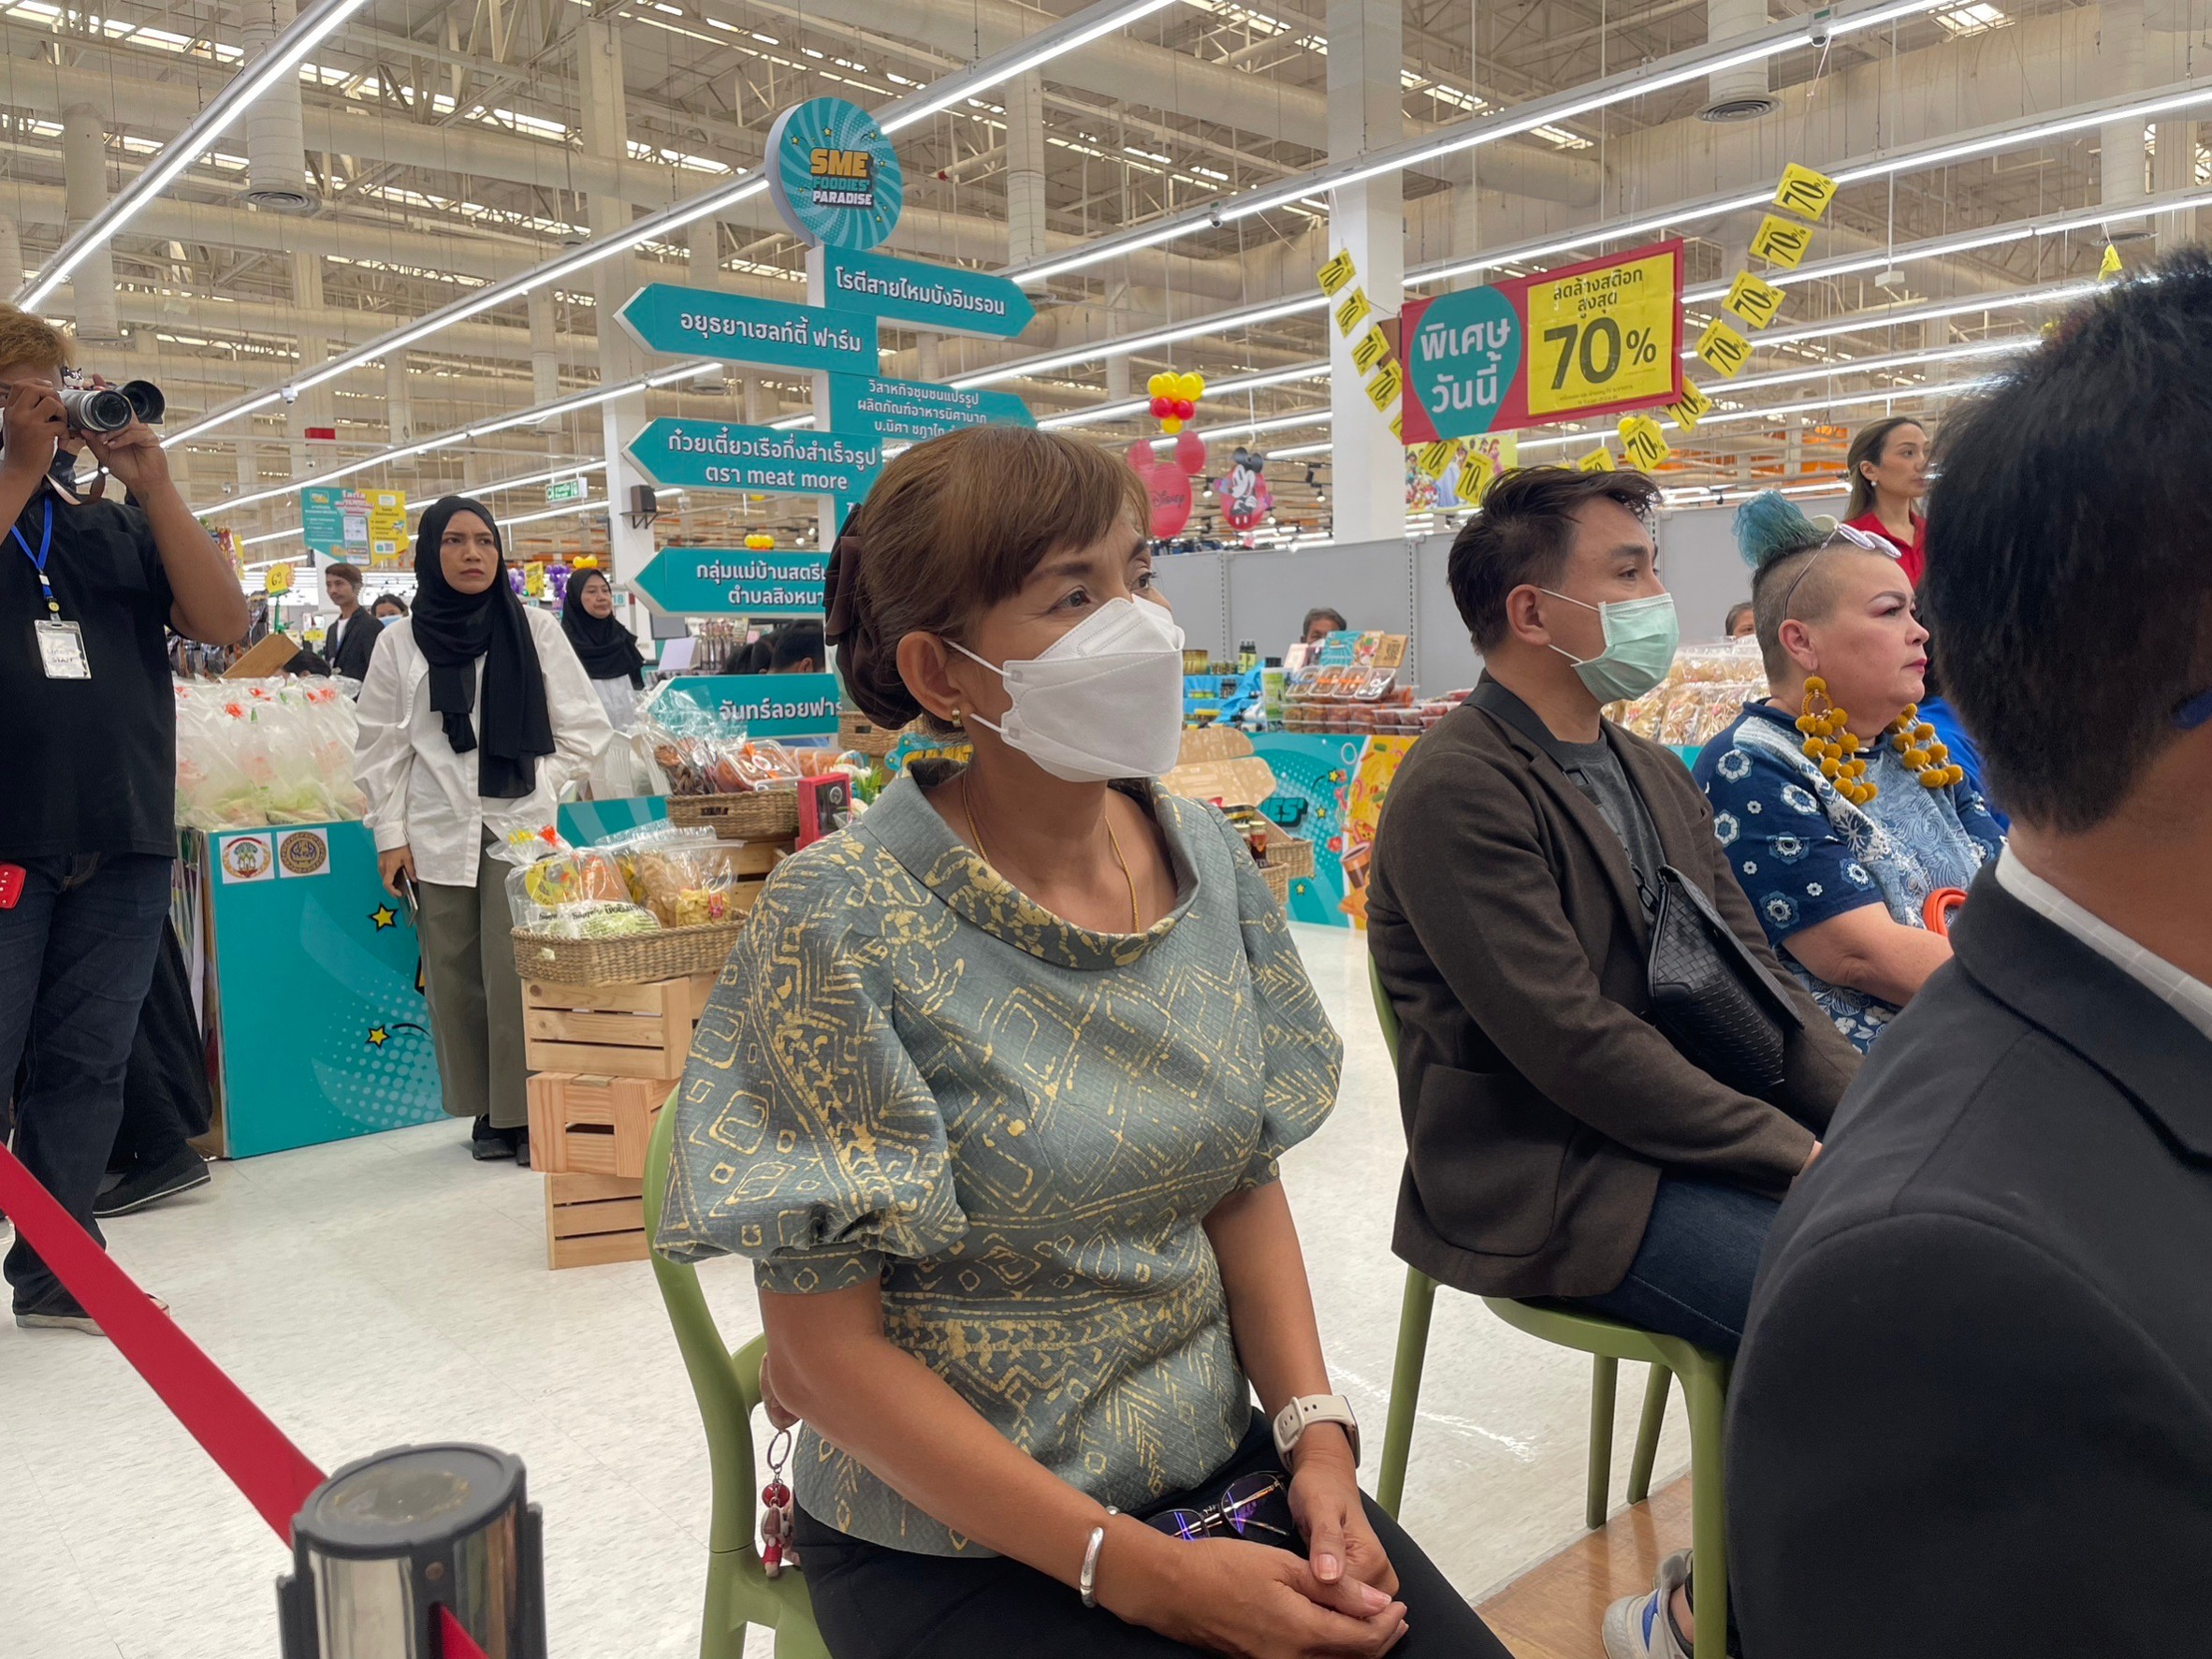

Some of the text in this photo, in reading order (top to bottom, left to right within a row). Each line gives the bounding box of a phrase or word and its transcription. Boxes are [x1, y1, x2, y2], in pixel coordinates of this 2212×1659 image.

[810, 148, 869, 178] SME
[813, 176, 870, 192] FOODIES'
[813, 190, 872, 205] PARADISE
[835, 266, 1006, 315] โรตีสายไหมบังอิมรอน
[1578, 292, 1618, 319] สูงสุด
[680, 313, 862, 352] อยุธยาเฮลท์ตี้ ฟาร์ม
[1420, 317, 1511, 362] พิเศษ
[1544, 317, 1657, 390] 70%
[868, 379, 979, 409] วิสาหกิจชุมชนแปรรูป
[1431, 351, 1502, 414] วันนี้
[668, 426, 877, 472] ก๋วยเตี๋ยวเรือกึ่งสำเร็จรูป
[706, 466, 849, 490] ตรา meat more
